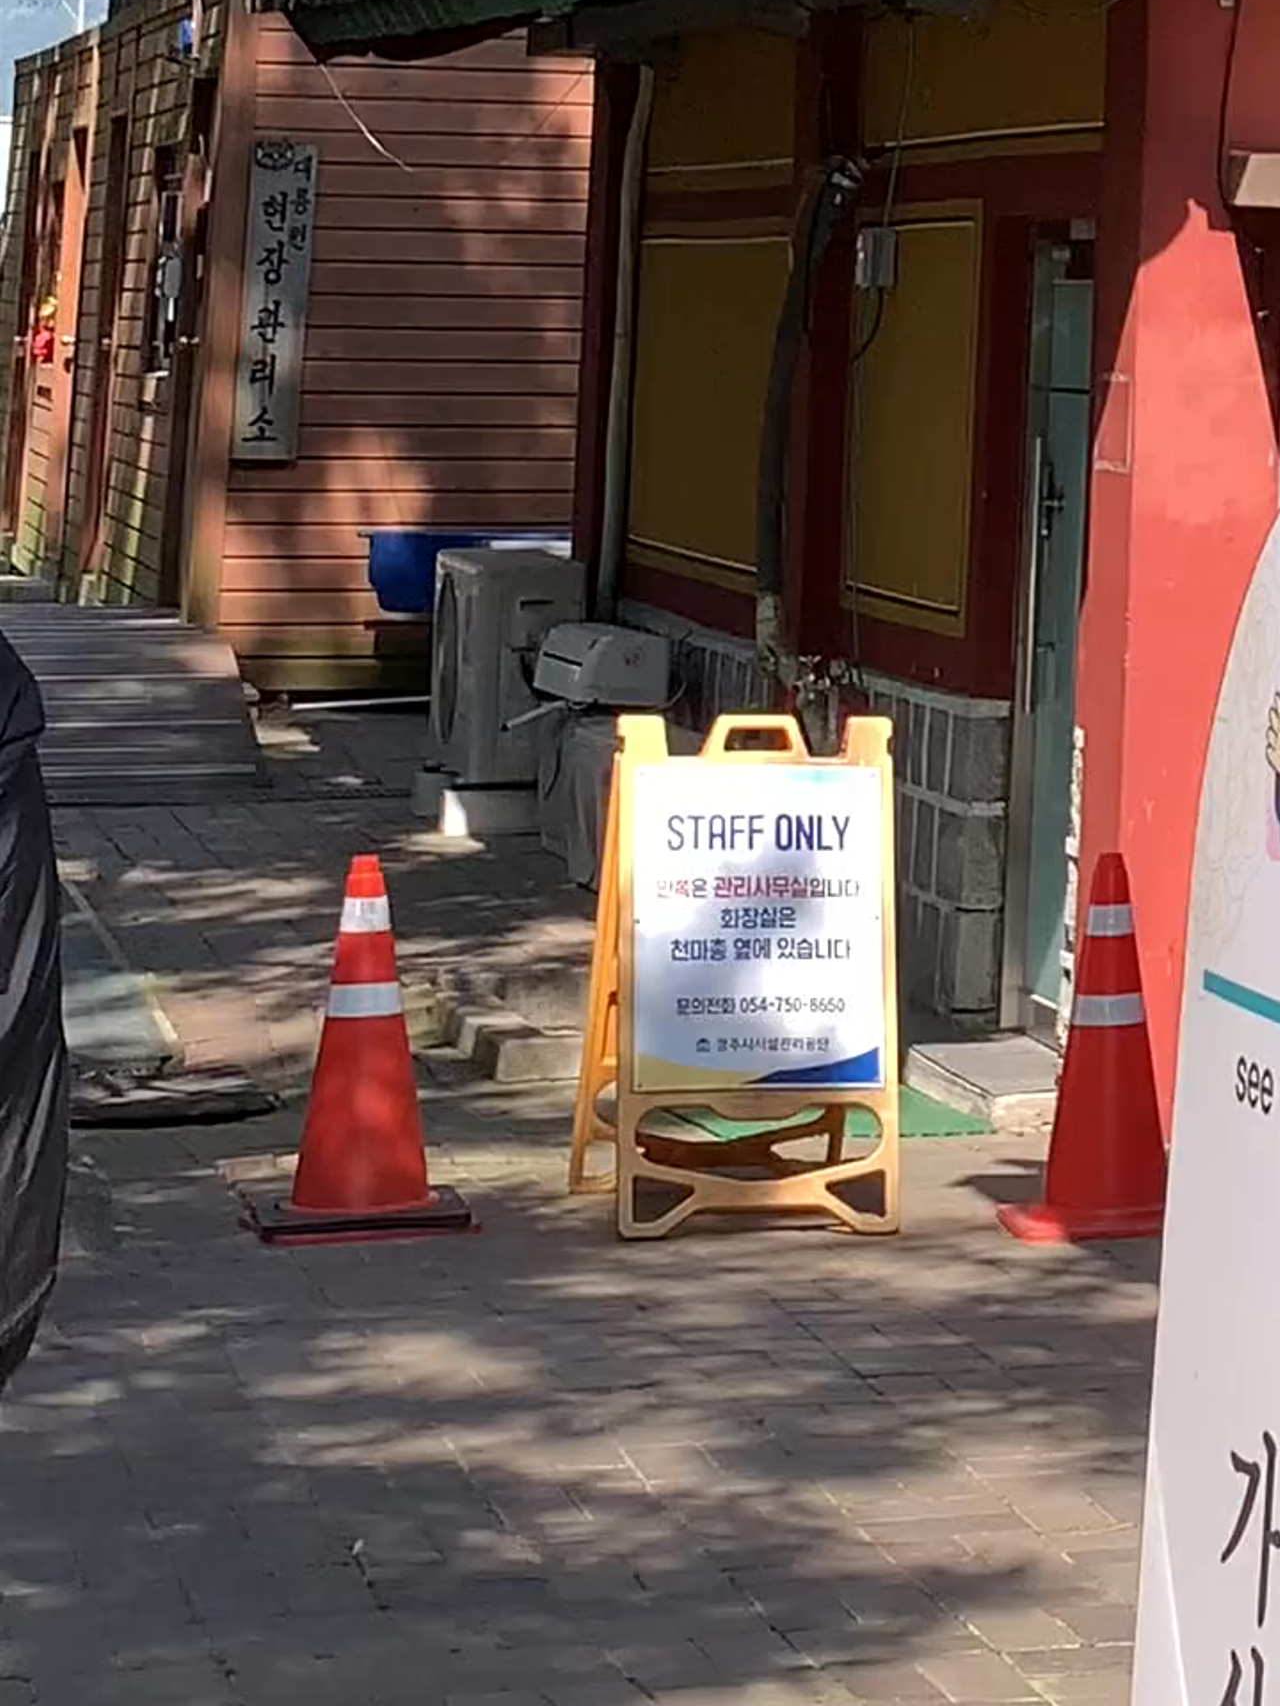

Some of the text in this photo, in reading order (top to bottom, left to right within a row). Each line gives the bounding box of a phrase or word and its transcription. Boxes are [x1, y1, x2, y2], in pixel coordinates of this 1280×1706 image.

[241, 191, 289, 443] 현장관리소
[667, 814, 850, 851] STAFF ONLY
[713, 875, 860, 900] 관리사무실입니다
[720, 906, 796, 929] 화장실은
[671, 937, 851, 961] 천마총 옆에 있습니다
[676, 997, 736, 1015] 문의전화
[1235, 1053, 1273, 1115] see
